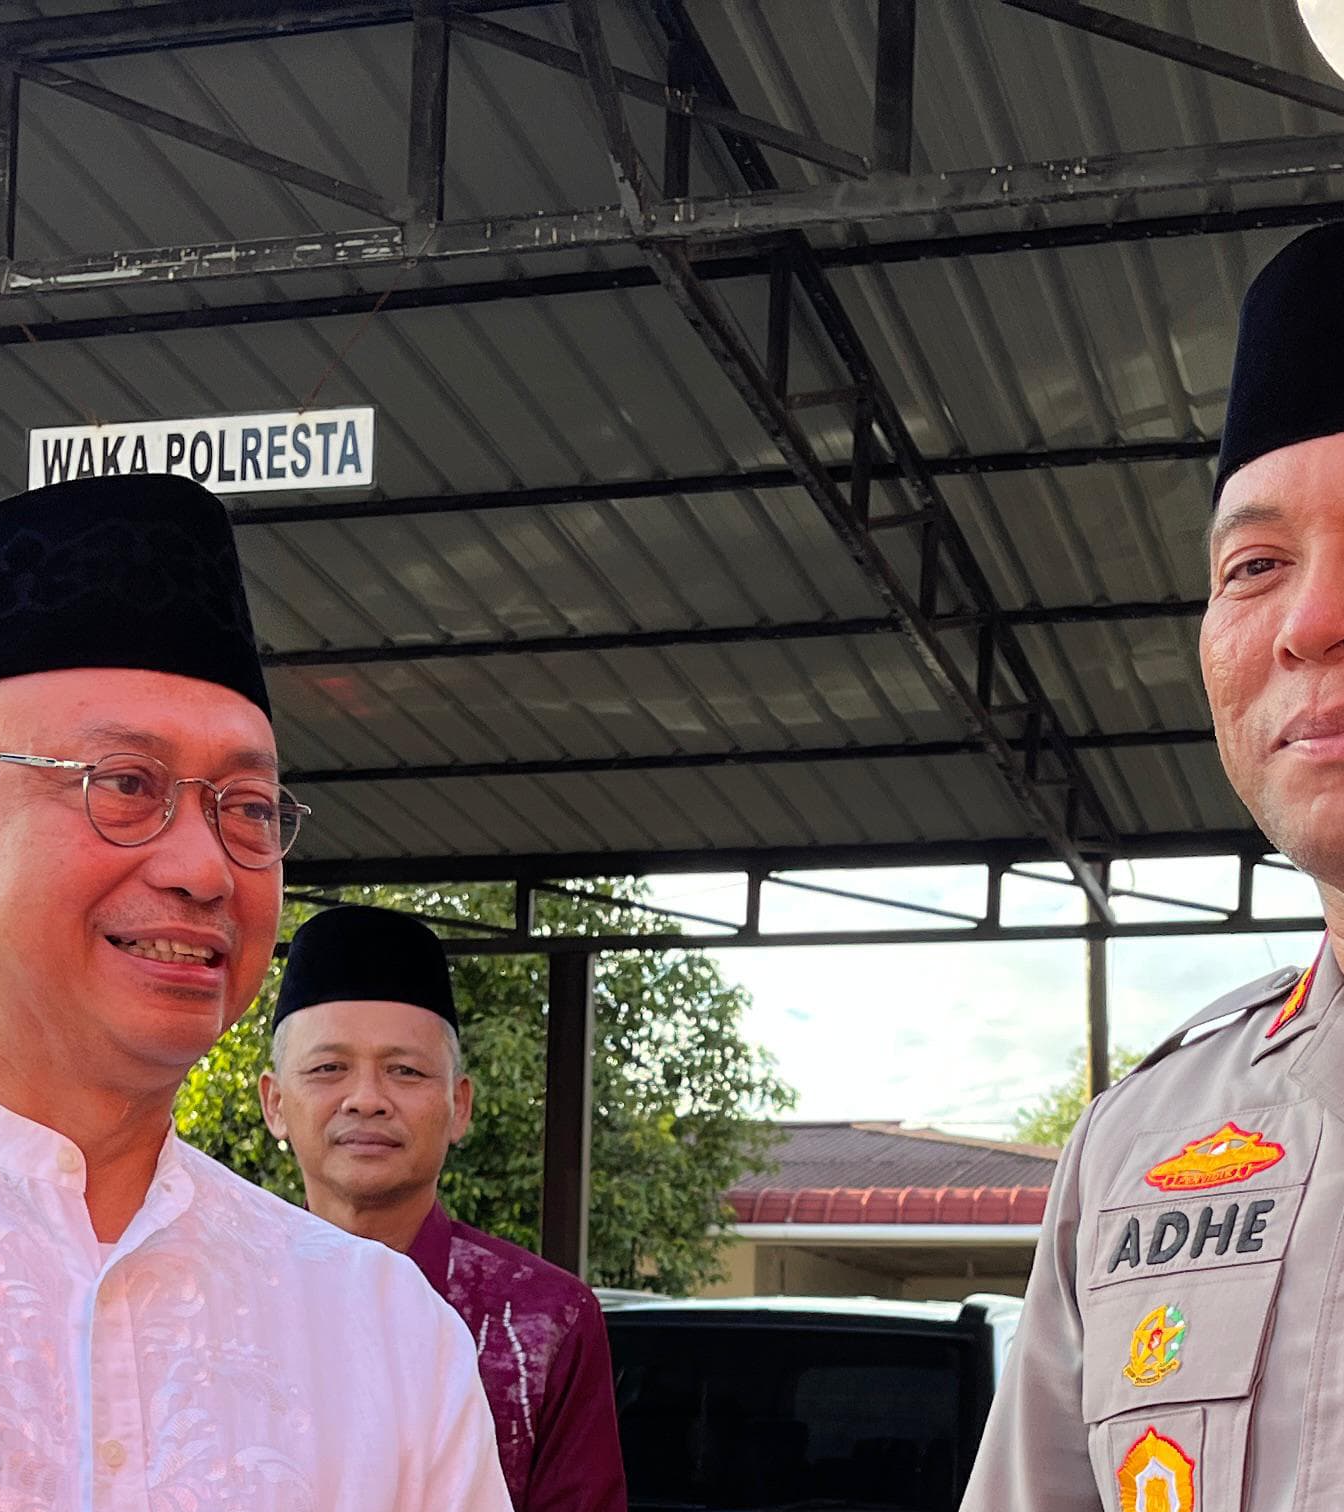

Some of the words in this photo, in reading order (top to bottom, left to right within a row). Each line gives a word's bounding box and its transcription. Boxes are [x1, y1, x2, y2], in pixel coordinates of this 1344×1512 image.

[42, 434, 149, 485] WAKA
[166, 420, 362, 482] POLRESTA
[1107, 1199, 1276, 1274] ADHE
